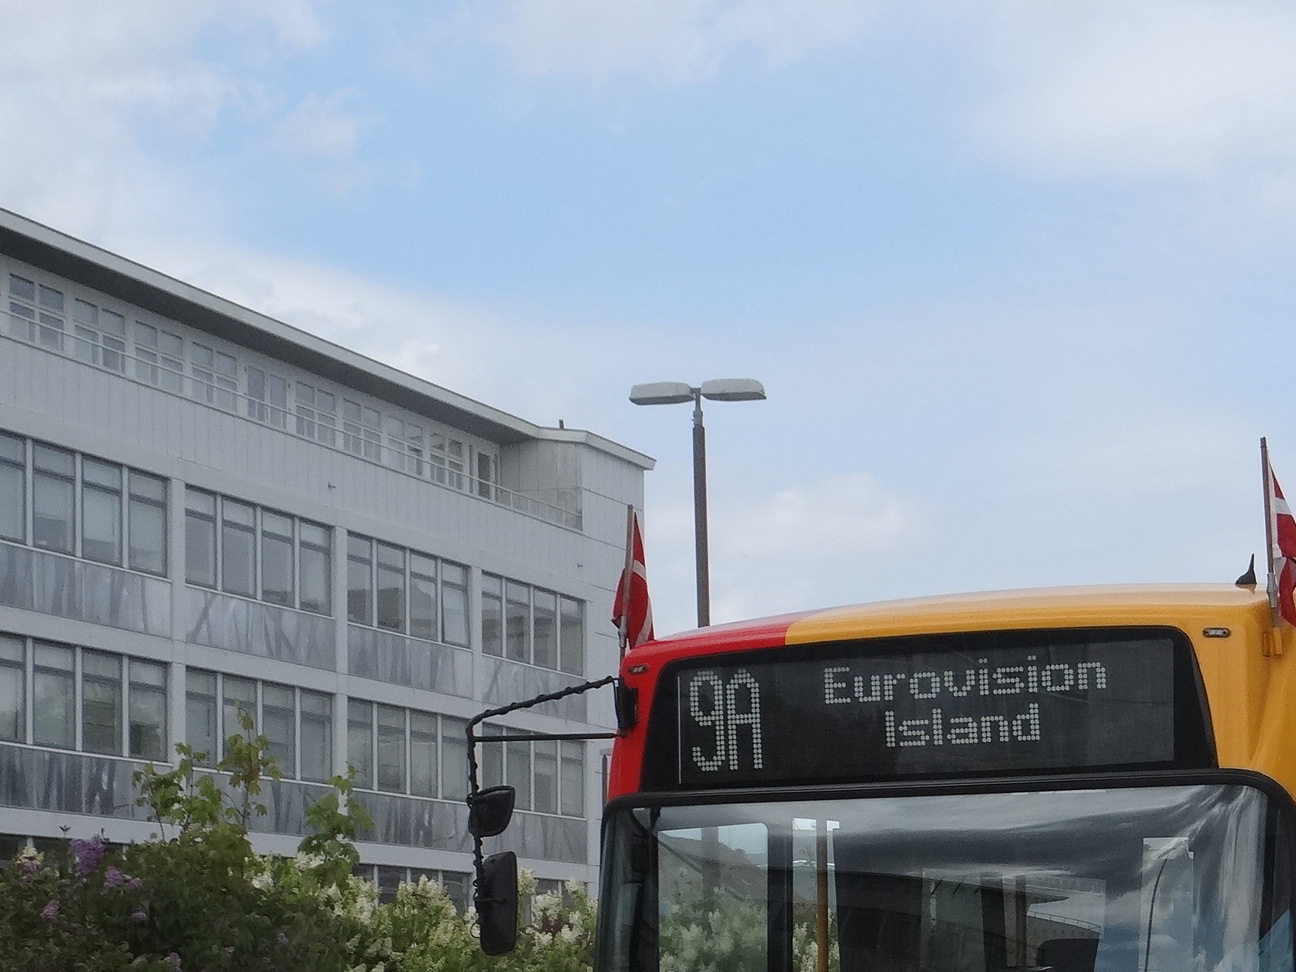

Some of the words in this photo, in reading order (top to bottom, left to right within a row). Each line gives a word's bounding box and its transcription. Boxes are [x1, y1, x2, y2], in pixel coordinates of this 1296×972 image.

[823, 655, 1107, 705] Eurovision
[688, 668, 764, 772] 9A
[885, 703, 1041, 748] Island
